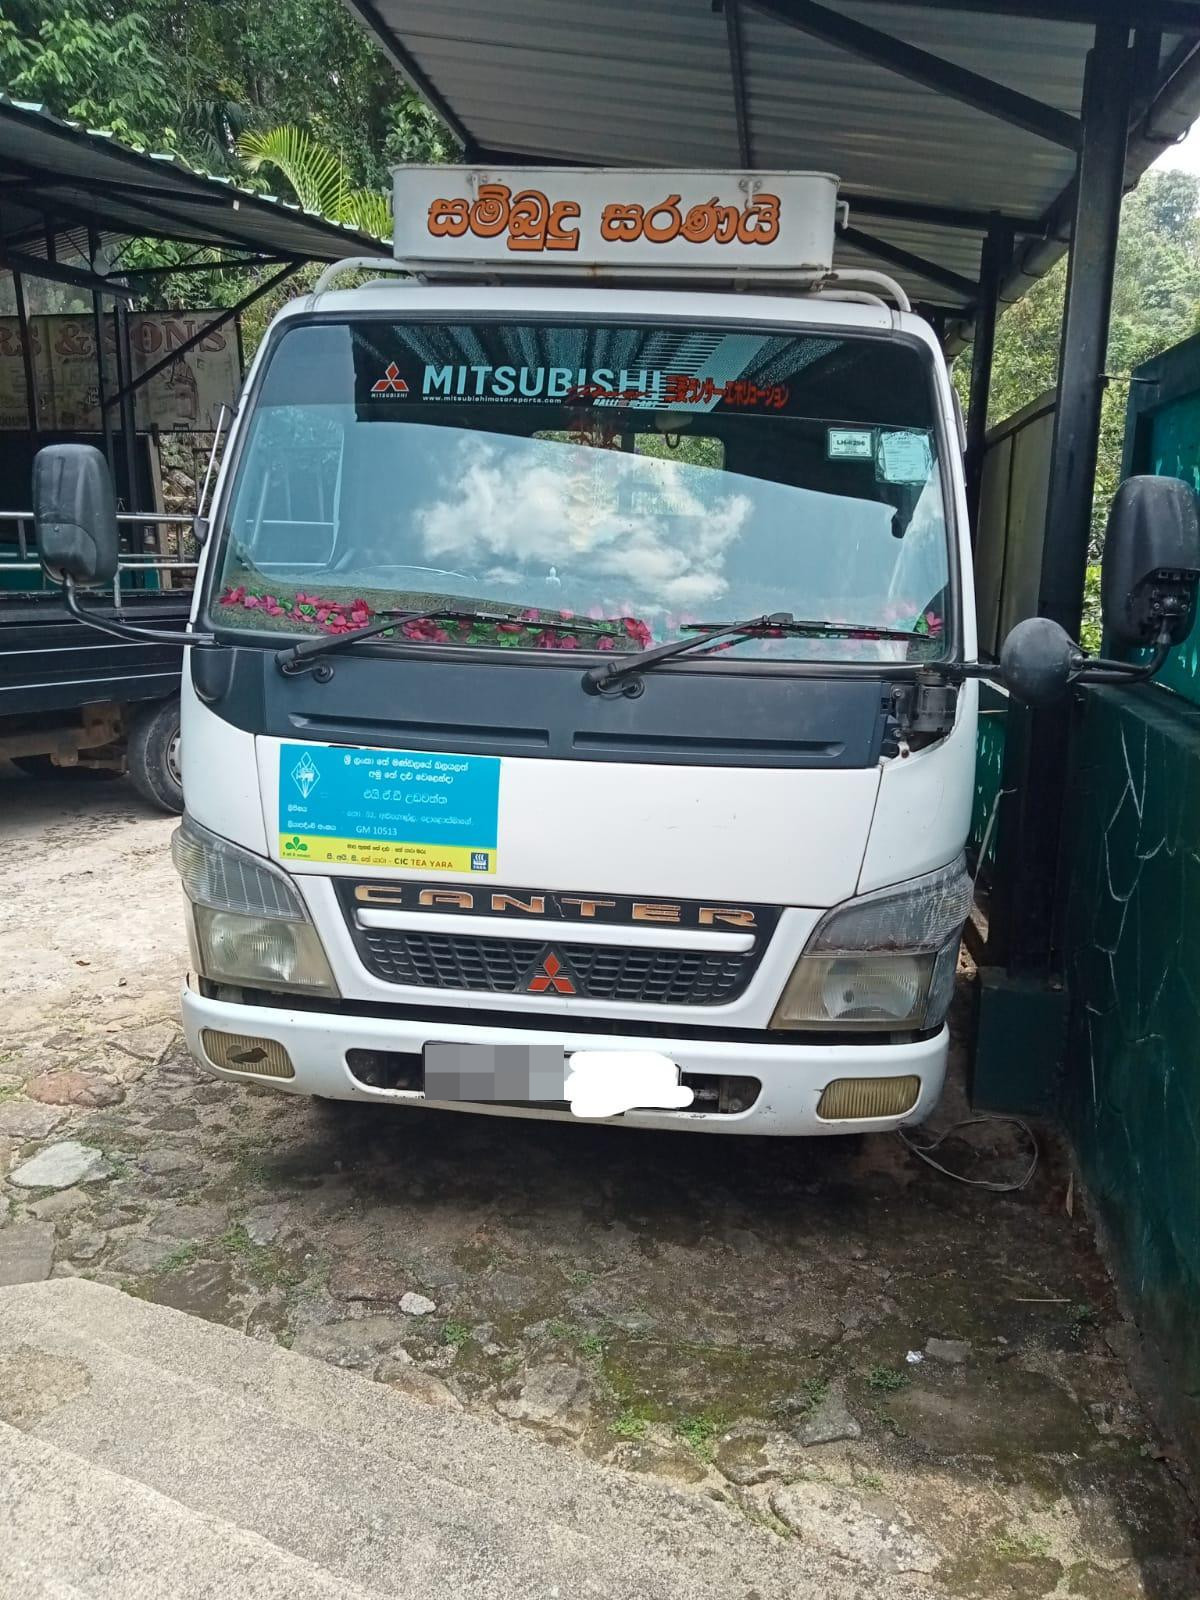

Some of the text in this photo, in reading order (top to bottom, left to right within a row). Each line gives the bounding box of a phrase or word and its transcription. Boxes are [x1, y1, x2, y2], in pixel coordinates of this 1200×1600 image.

[428, 184, 781, 251] සම්බුදු සරණයි
[422, 365, 662, 400] MITSUBISHI
[356, 825, 398, 836] GM 10513
[411, 859, 427, 867] TEA
[429, 860, 454, 869] YARA
[355, 884, 758, 928] CANTER
